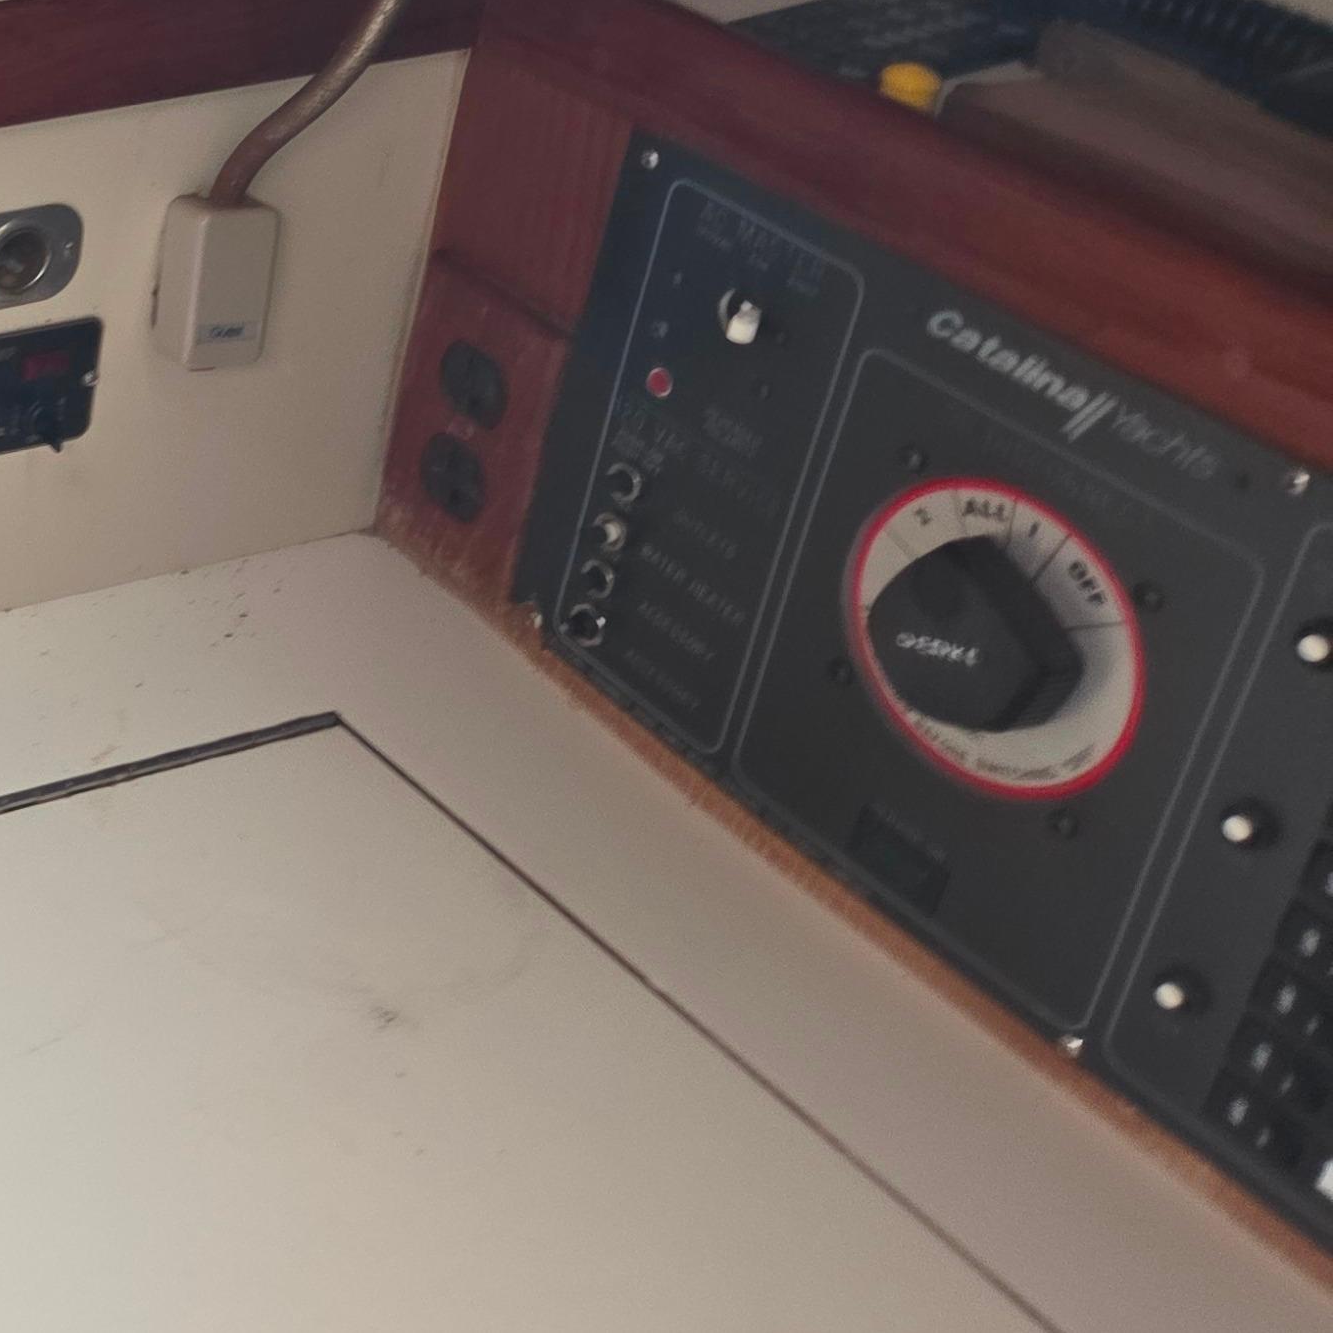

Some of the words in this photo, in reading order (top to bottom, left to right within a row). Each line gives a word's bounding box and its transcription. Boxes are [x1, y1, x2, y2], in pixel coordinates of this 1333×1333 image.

[926, 309, 1091, 414] Catalina
[961, 497, 1006, 523] ALL
[1068, 560, 1107, 606] OFF
